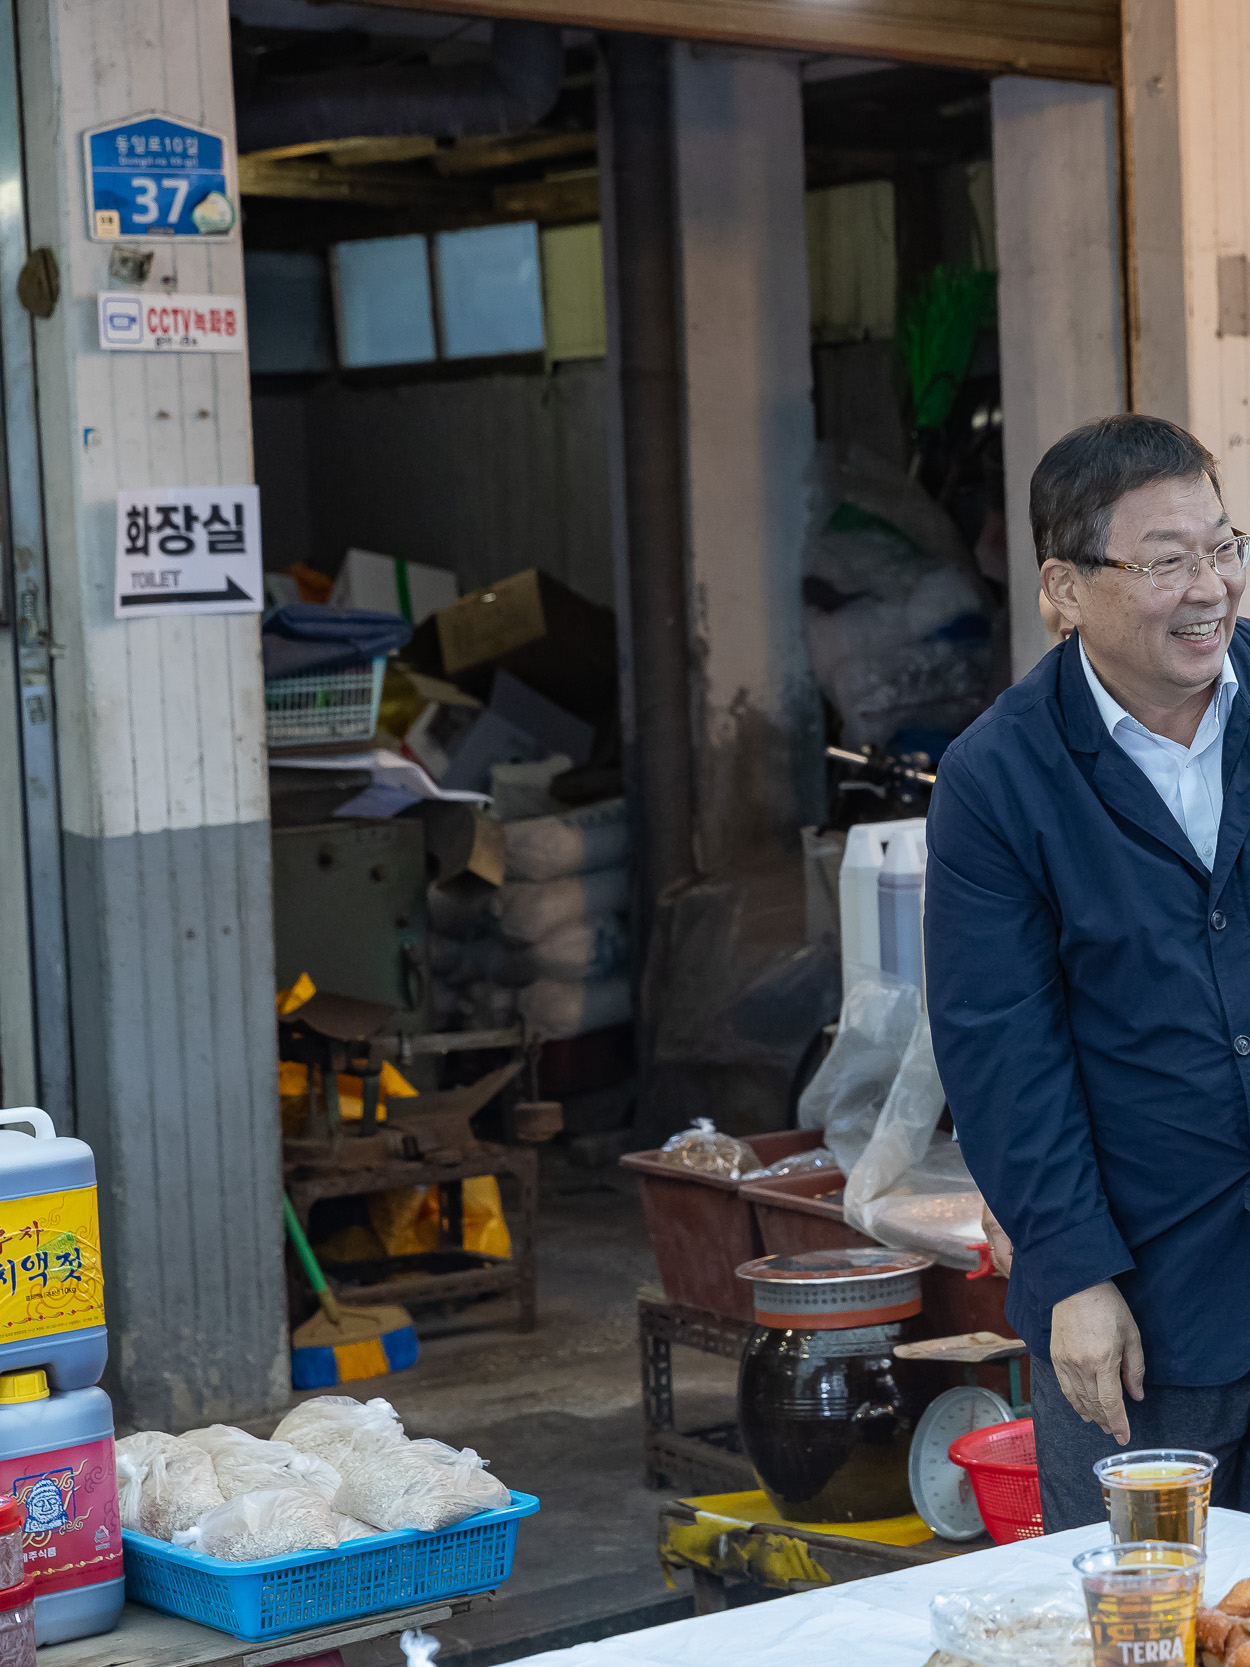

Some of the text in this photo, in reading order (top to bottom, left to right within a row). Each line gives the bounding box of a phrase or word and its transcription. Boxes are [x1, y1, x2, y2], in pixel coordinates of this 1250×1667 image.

[131, 176, 190, 224] 37
[147, 307, 237, 337] CCTV녹화중
[125, 503, 246, 556] 화장실
[131, 570, 182, 589] TOILET
[1117, 1636, 1184, 1666] TERRA
